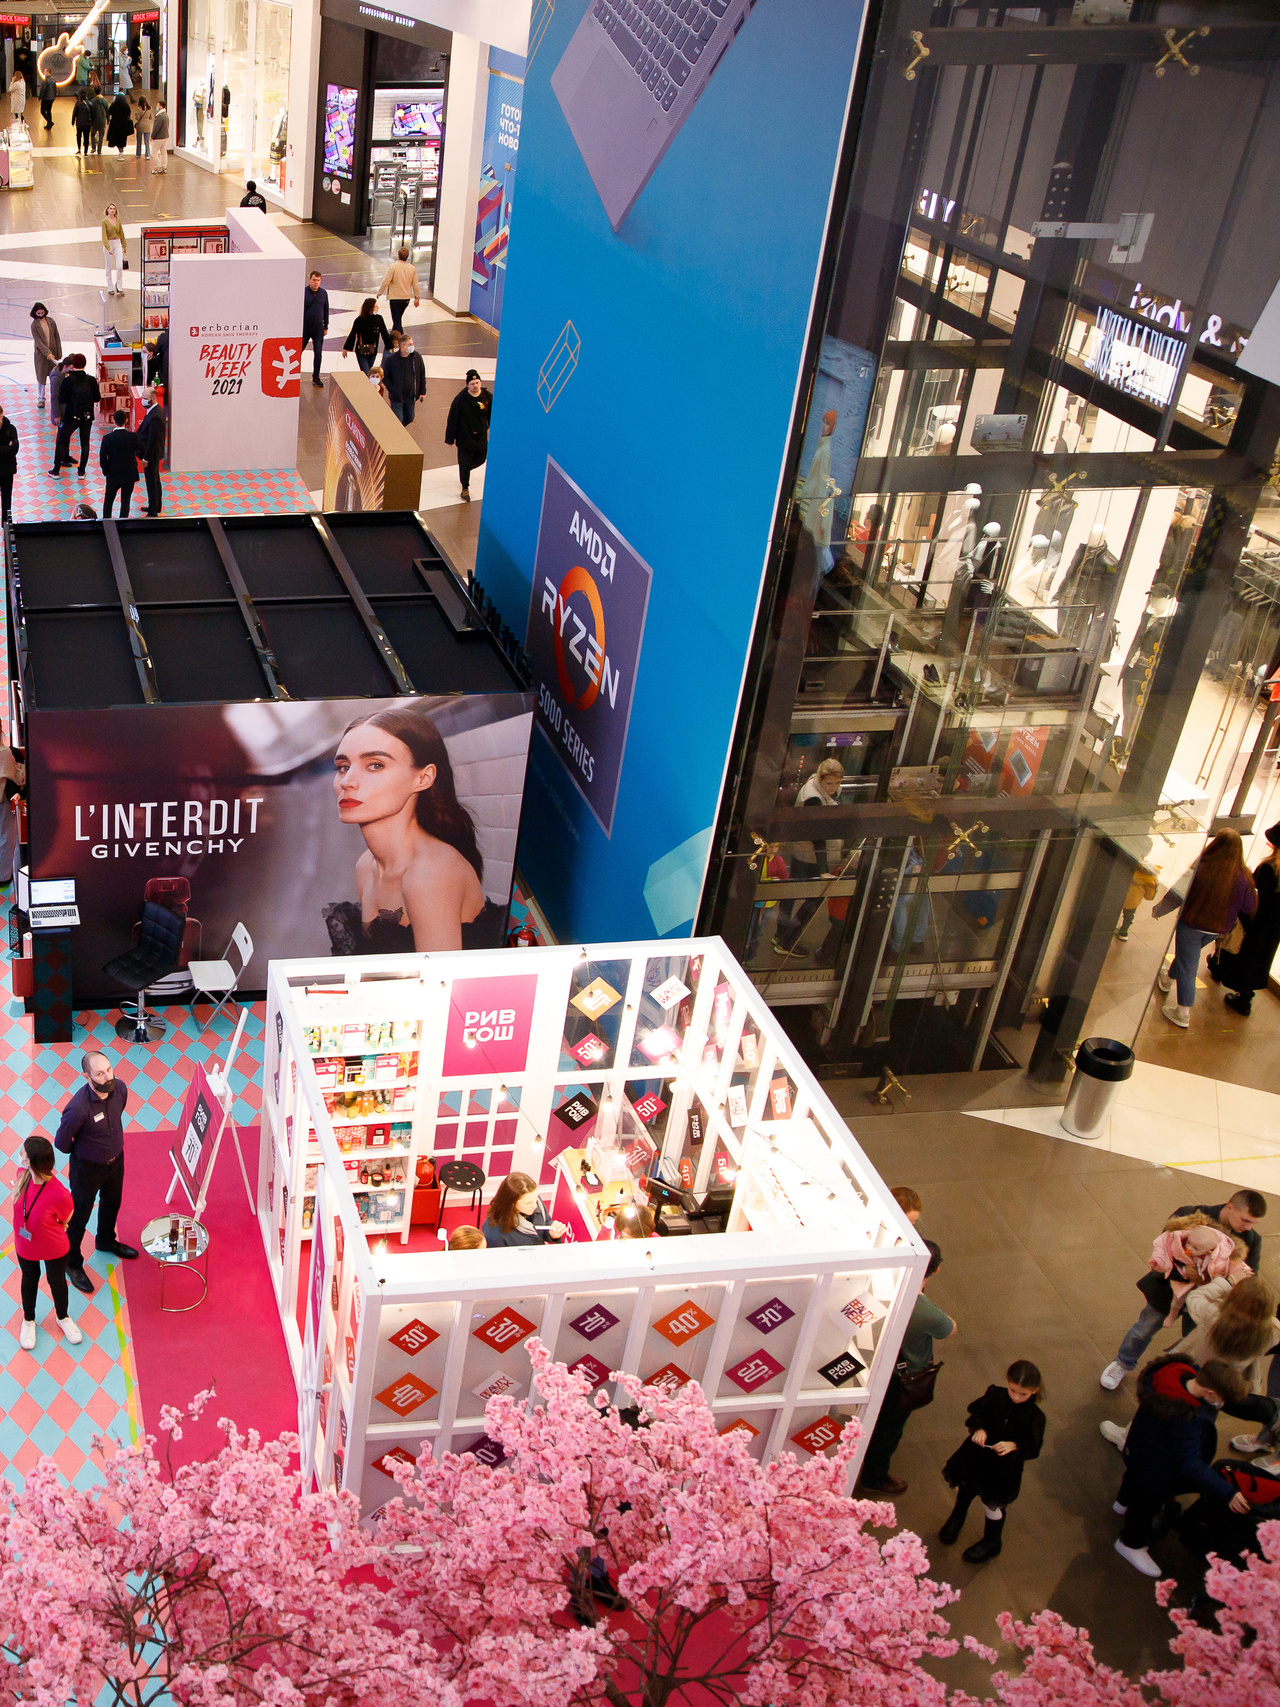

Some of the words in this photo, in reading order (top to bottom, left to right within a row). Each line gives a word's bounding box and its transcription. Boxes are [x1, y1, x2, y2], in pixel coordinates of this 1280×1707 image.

[0, 14, 13, 22] ROCK
[133, 13, 145, 21] ROCK
[146, 11, 159, 19] SHOP
[501, 102, 522, 122] ГОТО
[201, 323, 258, 331] erborian
[1199, 314, 1222, 347] &
[199, 343, 257, 361] BEAUTY
[205, 361, 251, 378] WEEK
[212, 378, 243, 395] 2021
[569, 509, 603, 566] AMD
[541, 577, 620, 709] RYZEN
[538, 682, 562, 733] 5000
[562, 724, 595, 783] SERIES
[75, 798, 264, 841] L'INTERDIT
[91, 838, 245, 859] GIVENCHY
[464, 1009, 516, 1027] РИВ
[463, 1026, 515, 1043] ГОШ
[564, 1107, 583, 1123] ГОШ
[571, 1101, 590, 1117] РИВ
[840, 1304, 868, 1328] WEEK
[849, 1298, 878, 1321] BEAUTY
[827, 1359, 849, 1376] РИВ
[832, 1363, 855, 1380] ГОШ
[479, 1376, 509, 1398] BEAUTY
